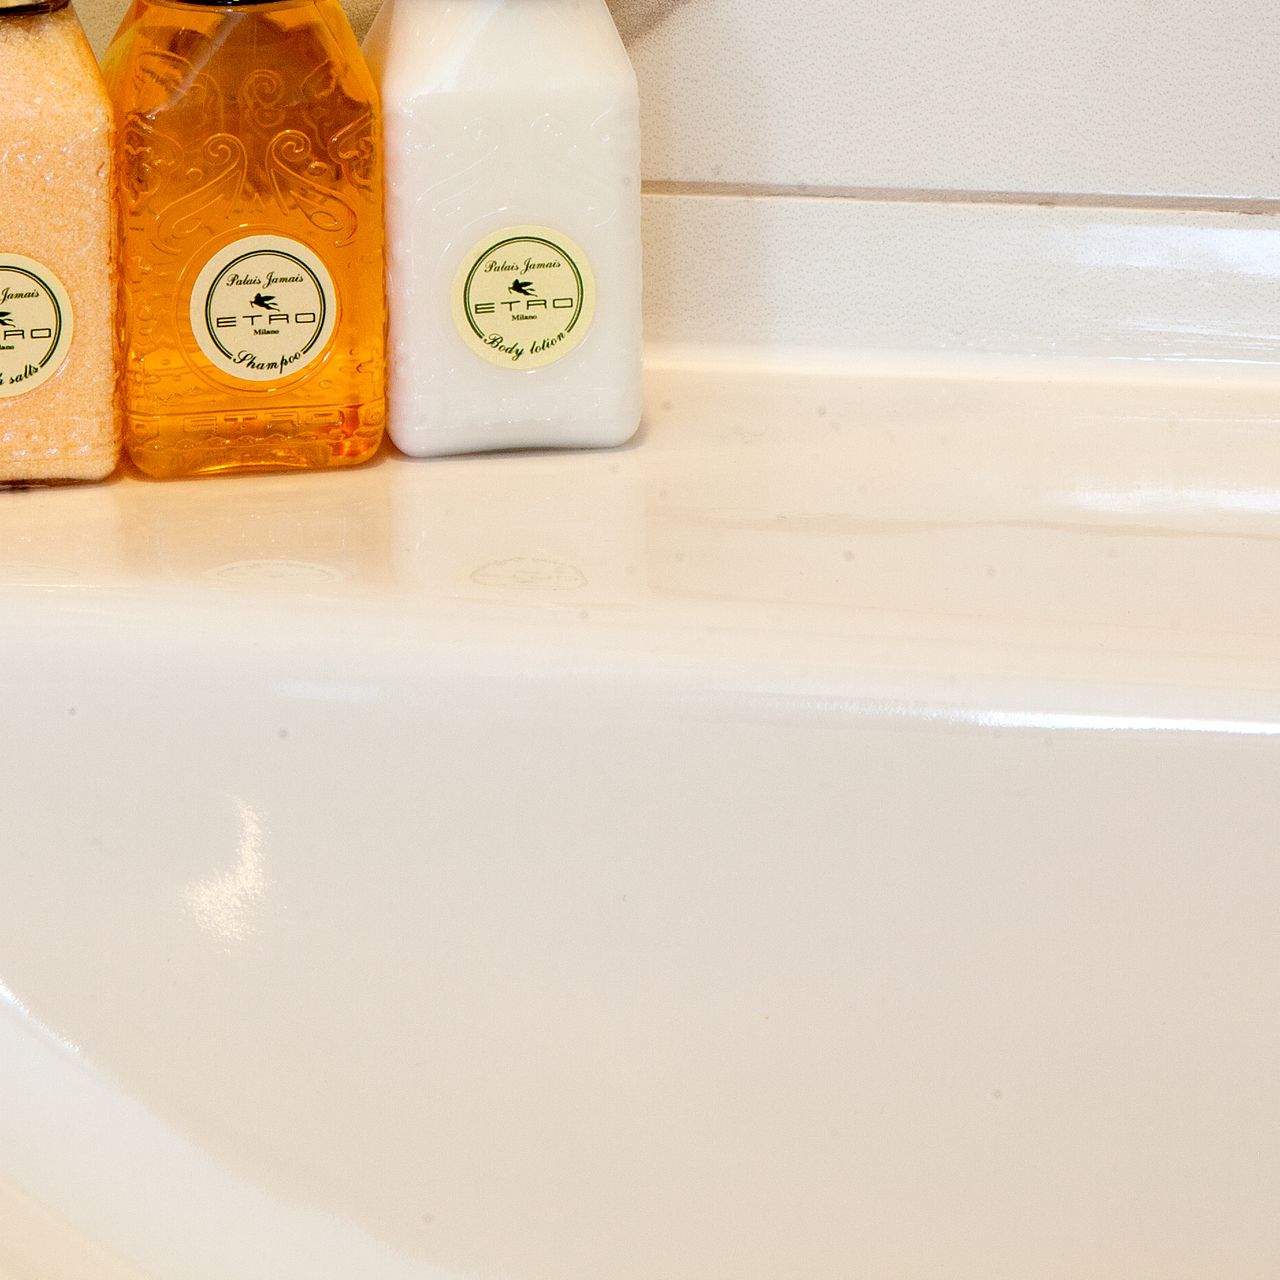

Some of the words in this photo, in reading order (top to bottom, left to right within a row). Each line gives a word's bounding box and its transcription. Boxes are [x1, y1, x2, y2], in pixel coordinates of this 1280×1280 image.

[484, 260, 520, 273] Palais
[520, 257, 561, 275] Jamais
[226, 273, 262, 287] Palais
[262, 271, 304, 289] Jamais
[474, 297, 573, 314] ETRO
[216, 312, 316, 328] ETRO
[483, 332, 524, 362] Body
[529, 331, 566, 355] lotion
[233, 350, 301, 374] Shampoo
[9, 364, 39, 385] salts
